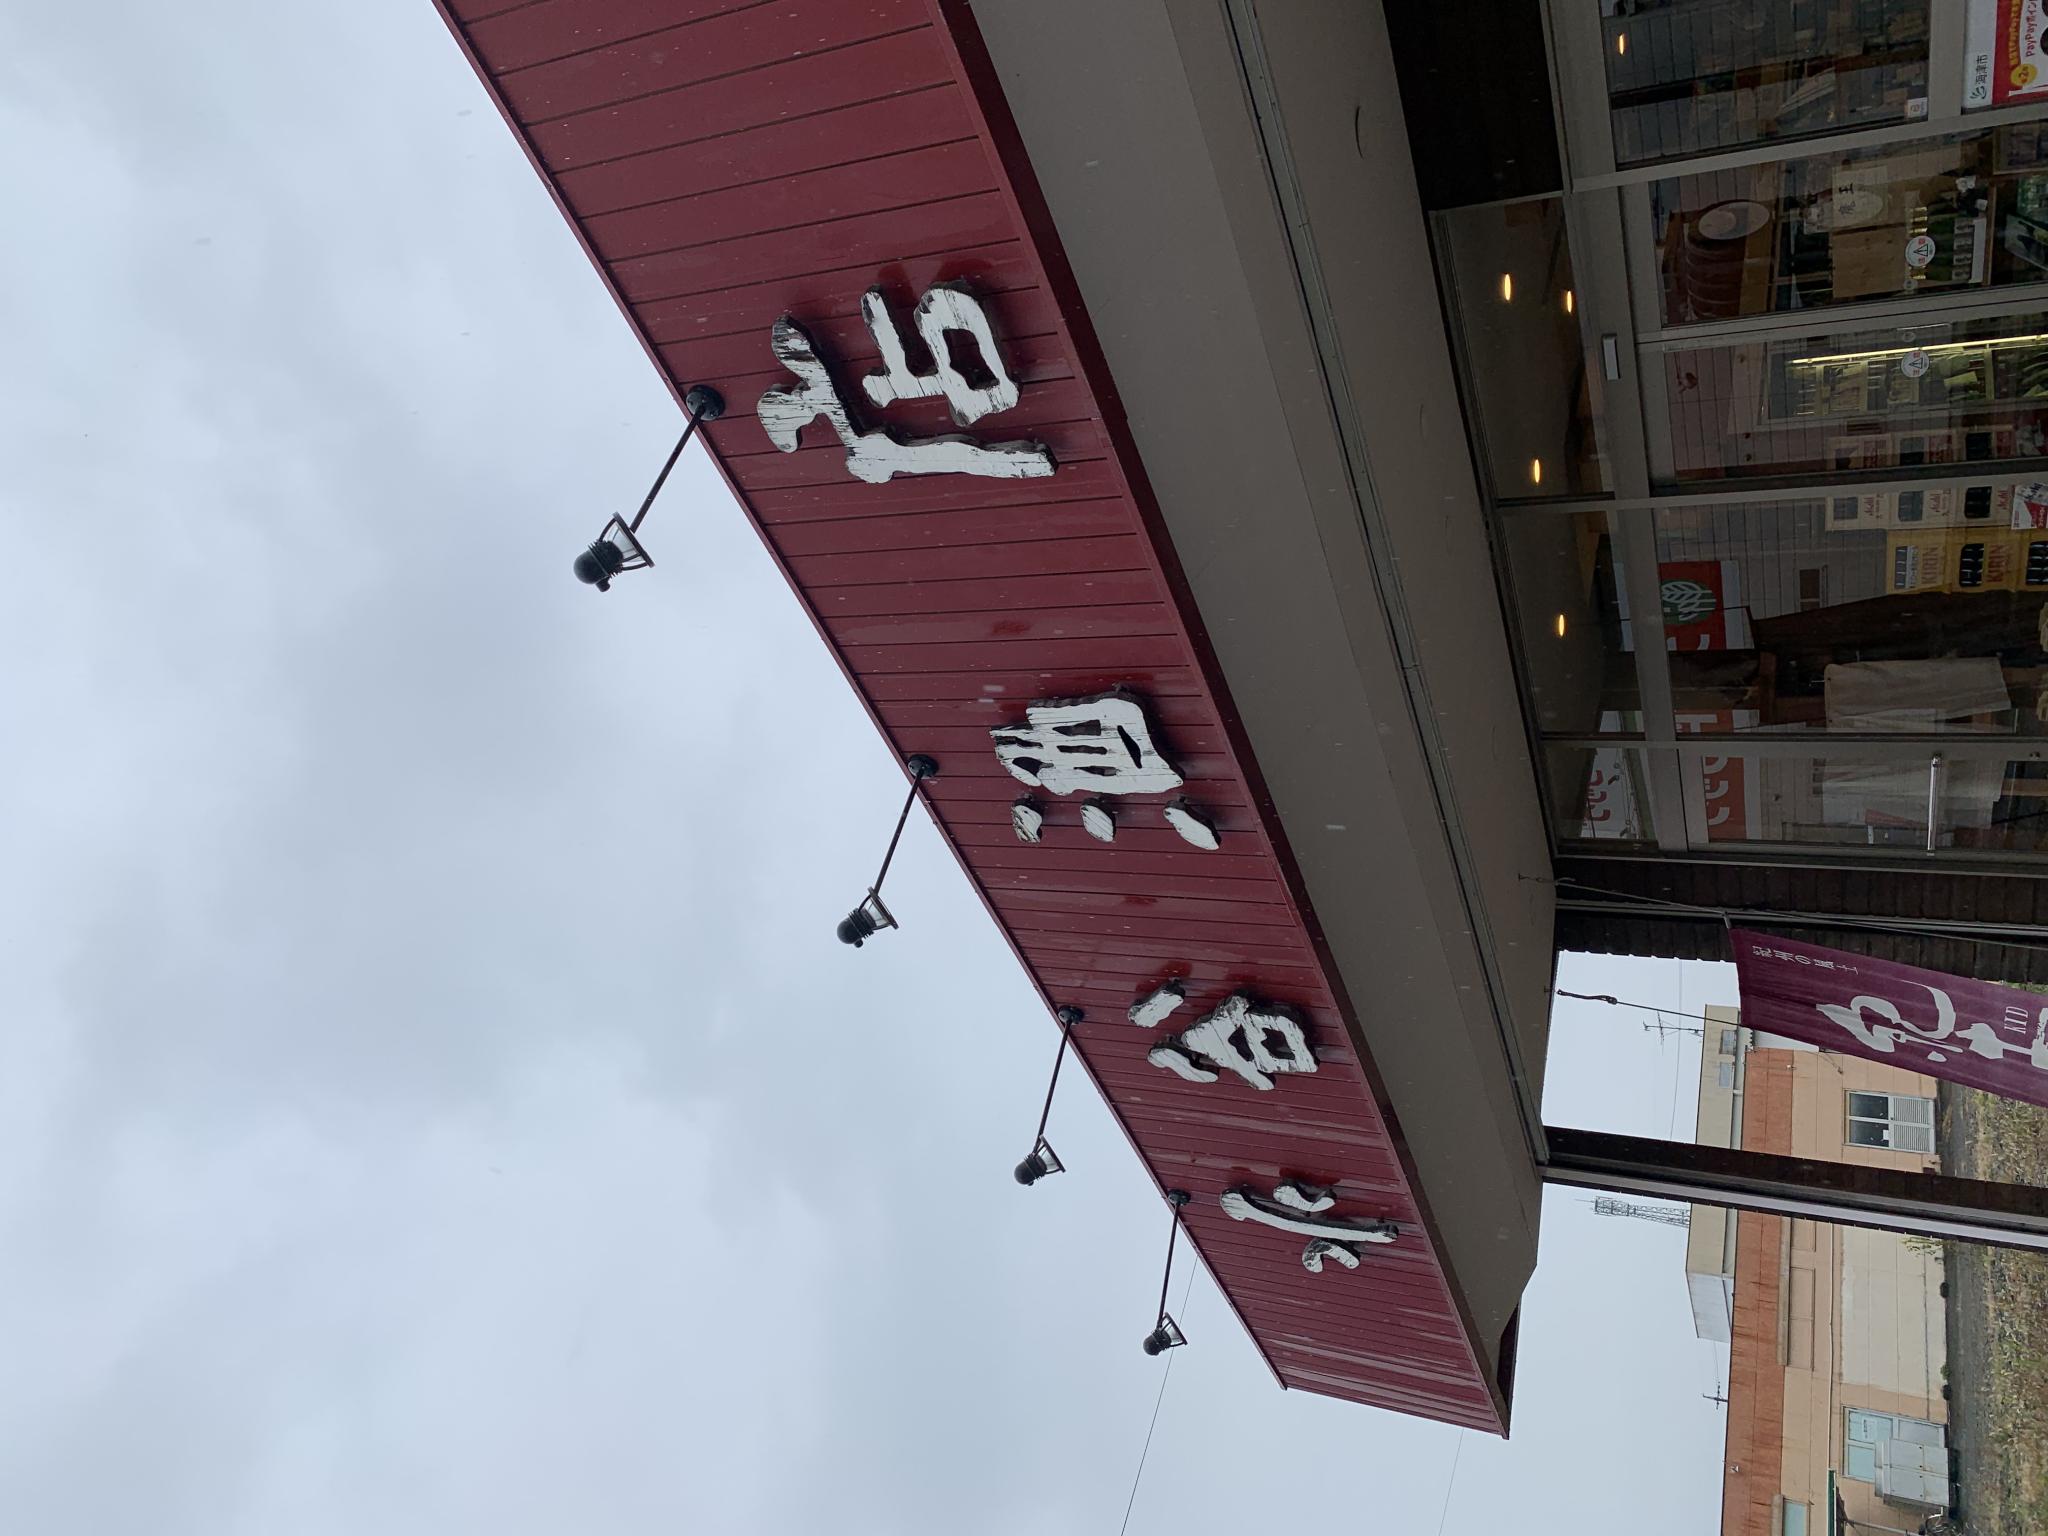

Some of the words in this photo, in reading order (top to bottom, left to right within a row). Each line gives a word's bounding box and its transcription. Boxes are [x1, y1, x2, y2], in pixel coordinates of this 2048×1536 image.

[1975, 54, 1988, 84] 海津市
[1921, 547, 1939, 584] KIRIN
[1986, 544, 2004, 582] KIRIN
[2004, 1006, 2028, 1034] KID
